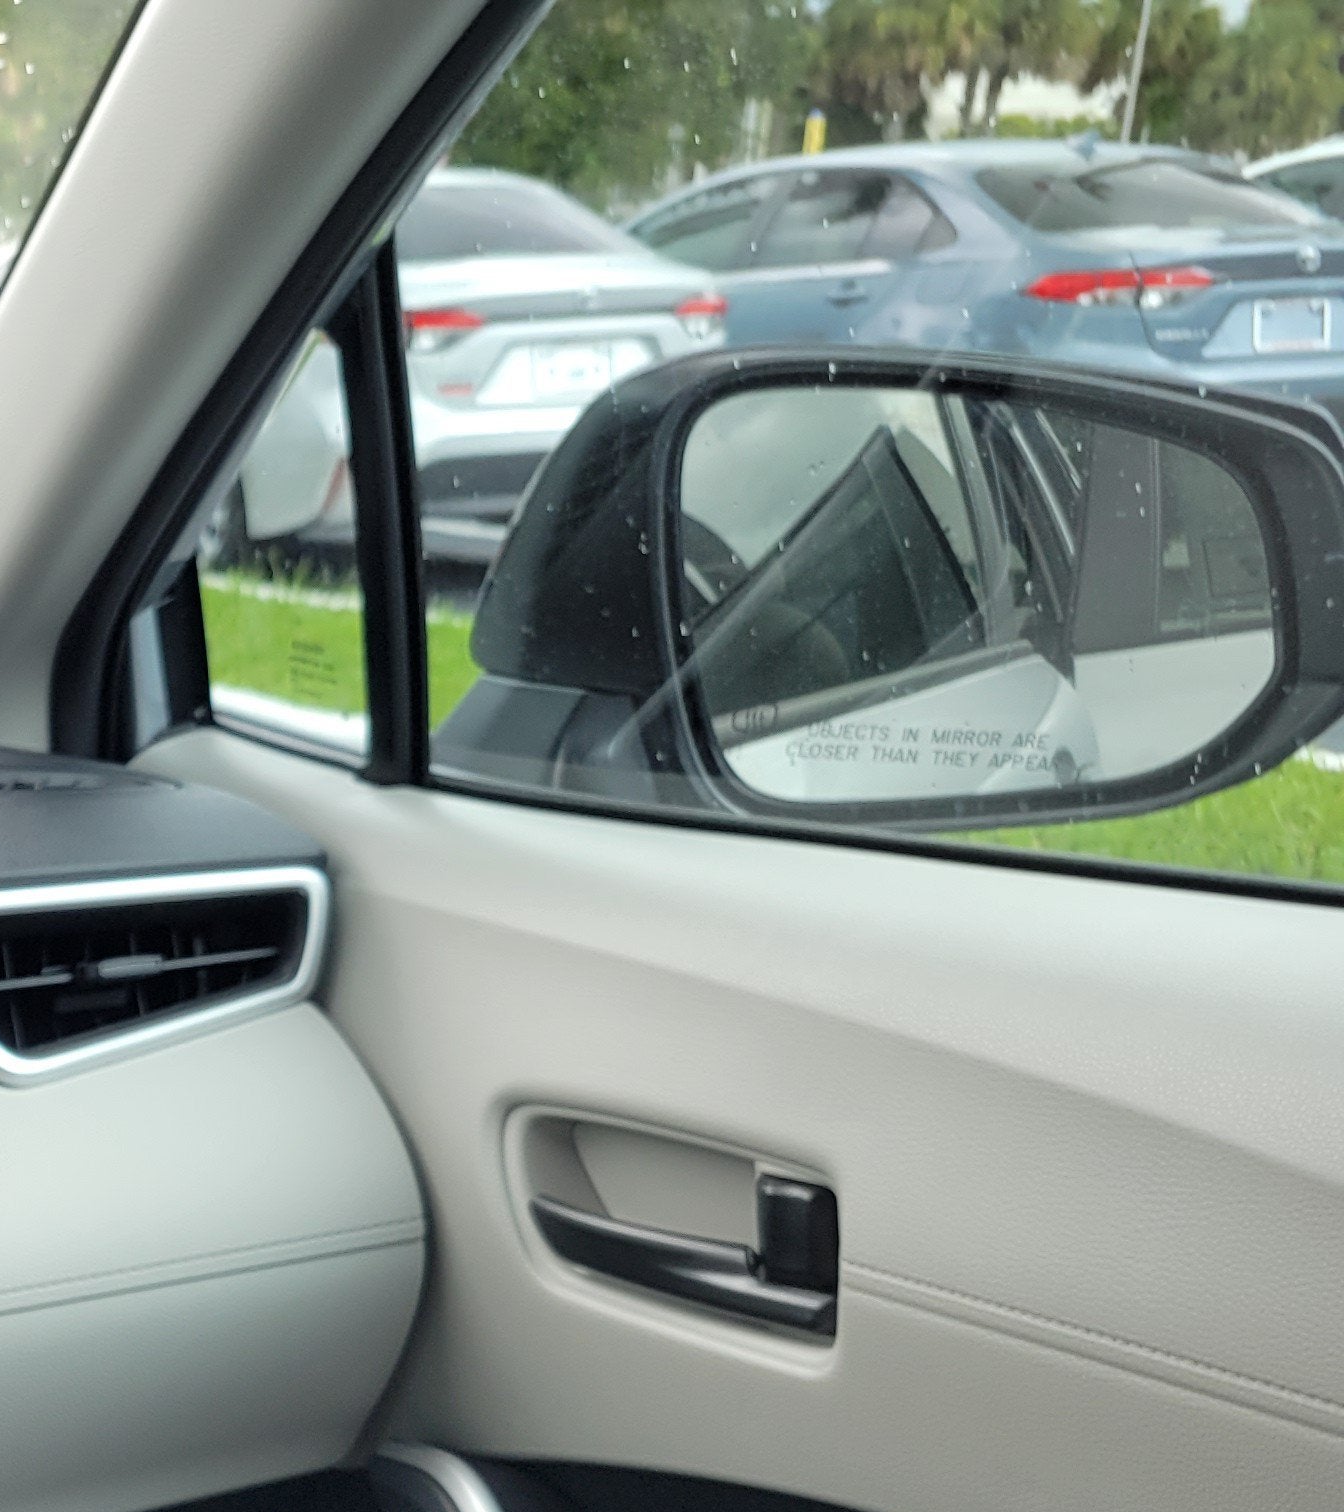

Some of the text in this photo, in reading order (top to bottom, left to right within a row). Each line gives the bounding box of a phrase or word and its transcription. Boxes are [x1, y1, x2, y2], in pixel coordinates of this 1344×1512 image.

[808, 721, 1051, 749] OBJECTS IN MIRROR ARE
[785, 742, 859, 761] CLOSER
[872, 744, 918, 764] THAN
[932, 750, 980, 767] THEY
